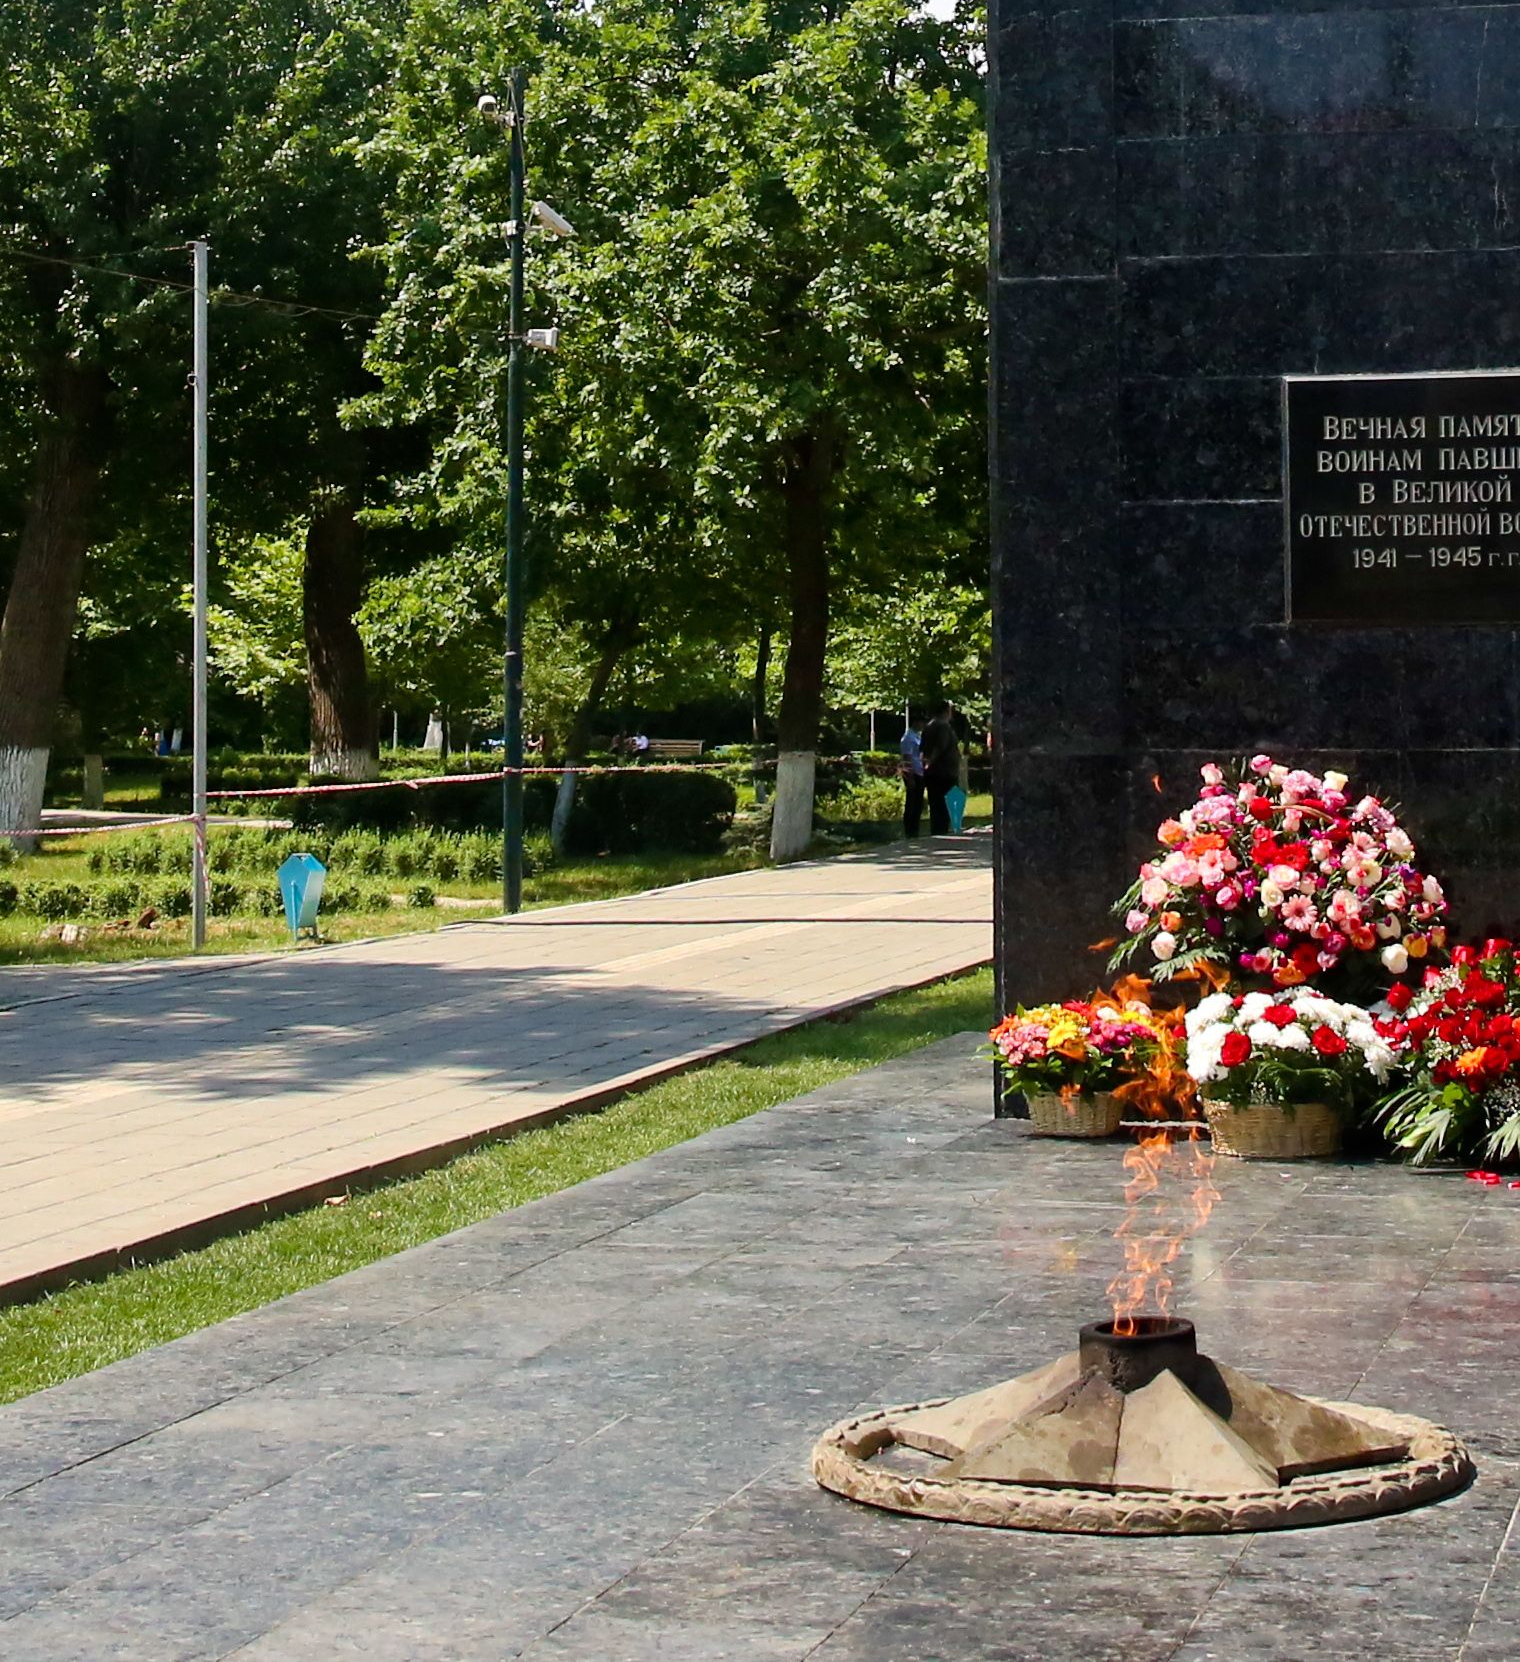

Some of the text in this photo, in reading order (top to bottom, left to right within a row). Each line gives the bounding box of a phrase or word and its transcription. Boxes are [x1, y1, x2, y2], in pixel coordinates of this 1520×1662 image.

[1323, 415, 1426, 440] ВЕЧНАЯ
[1317, 449, 1422, 473] ВОИНАМ
[1358, 474, 1512, 505] В ВЕЛИКОЙ
[1299, 508, 1491, 538] ОТЕЧЕСТВЕННОЙ
[1352, 547, 1397, 569] 1941
[1428, 545, 1482, 568] 1945
